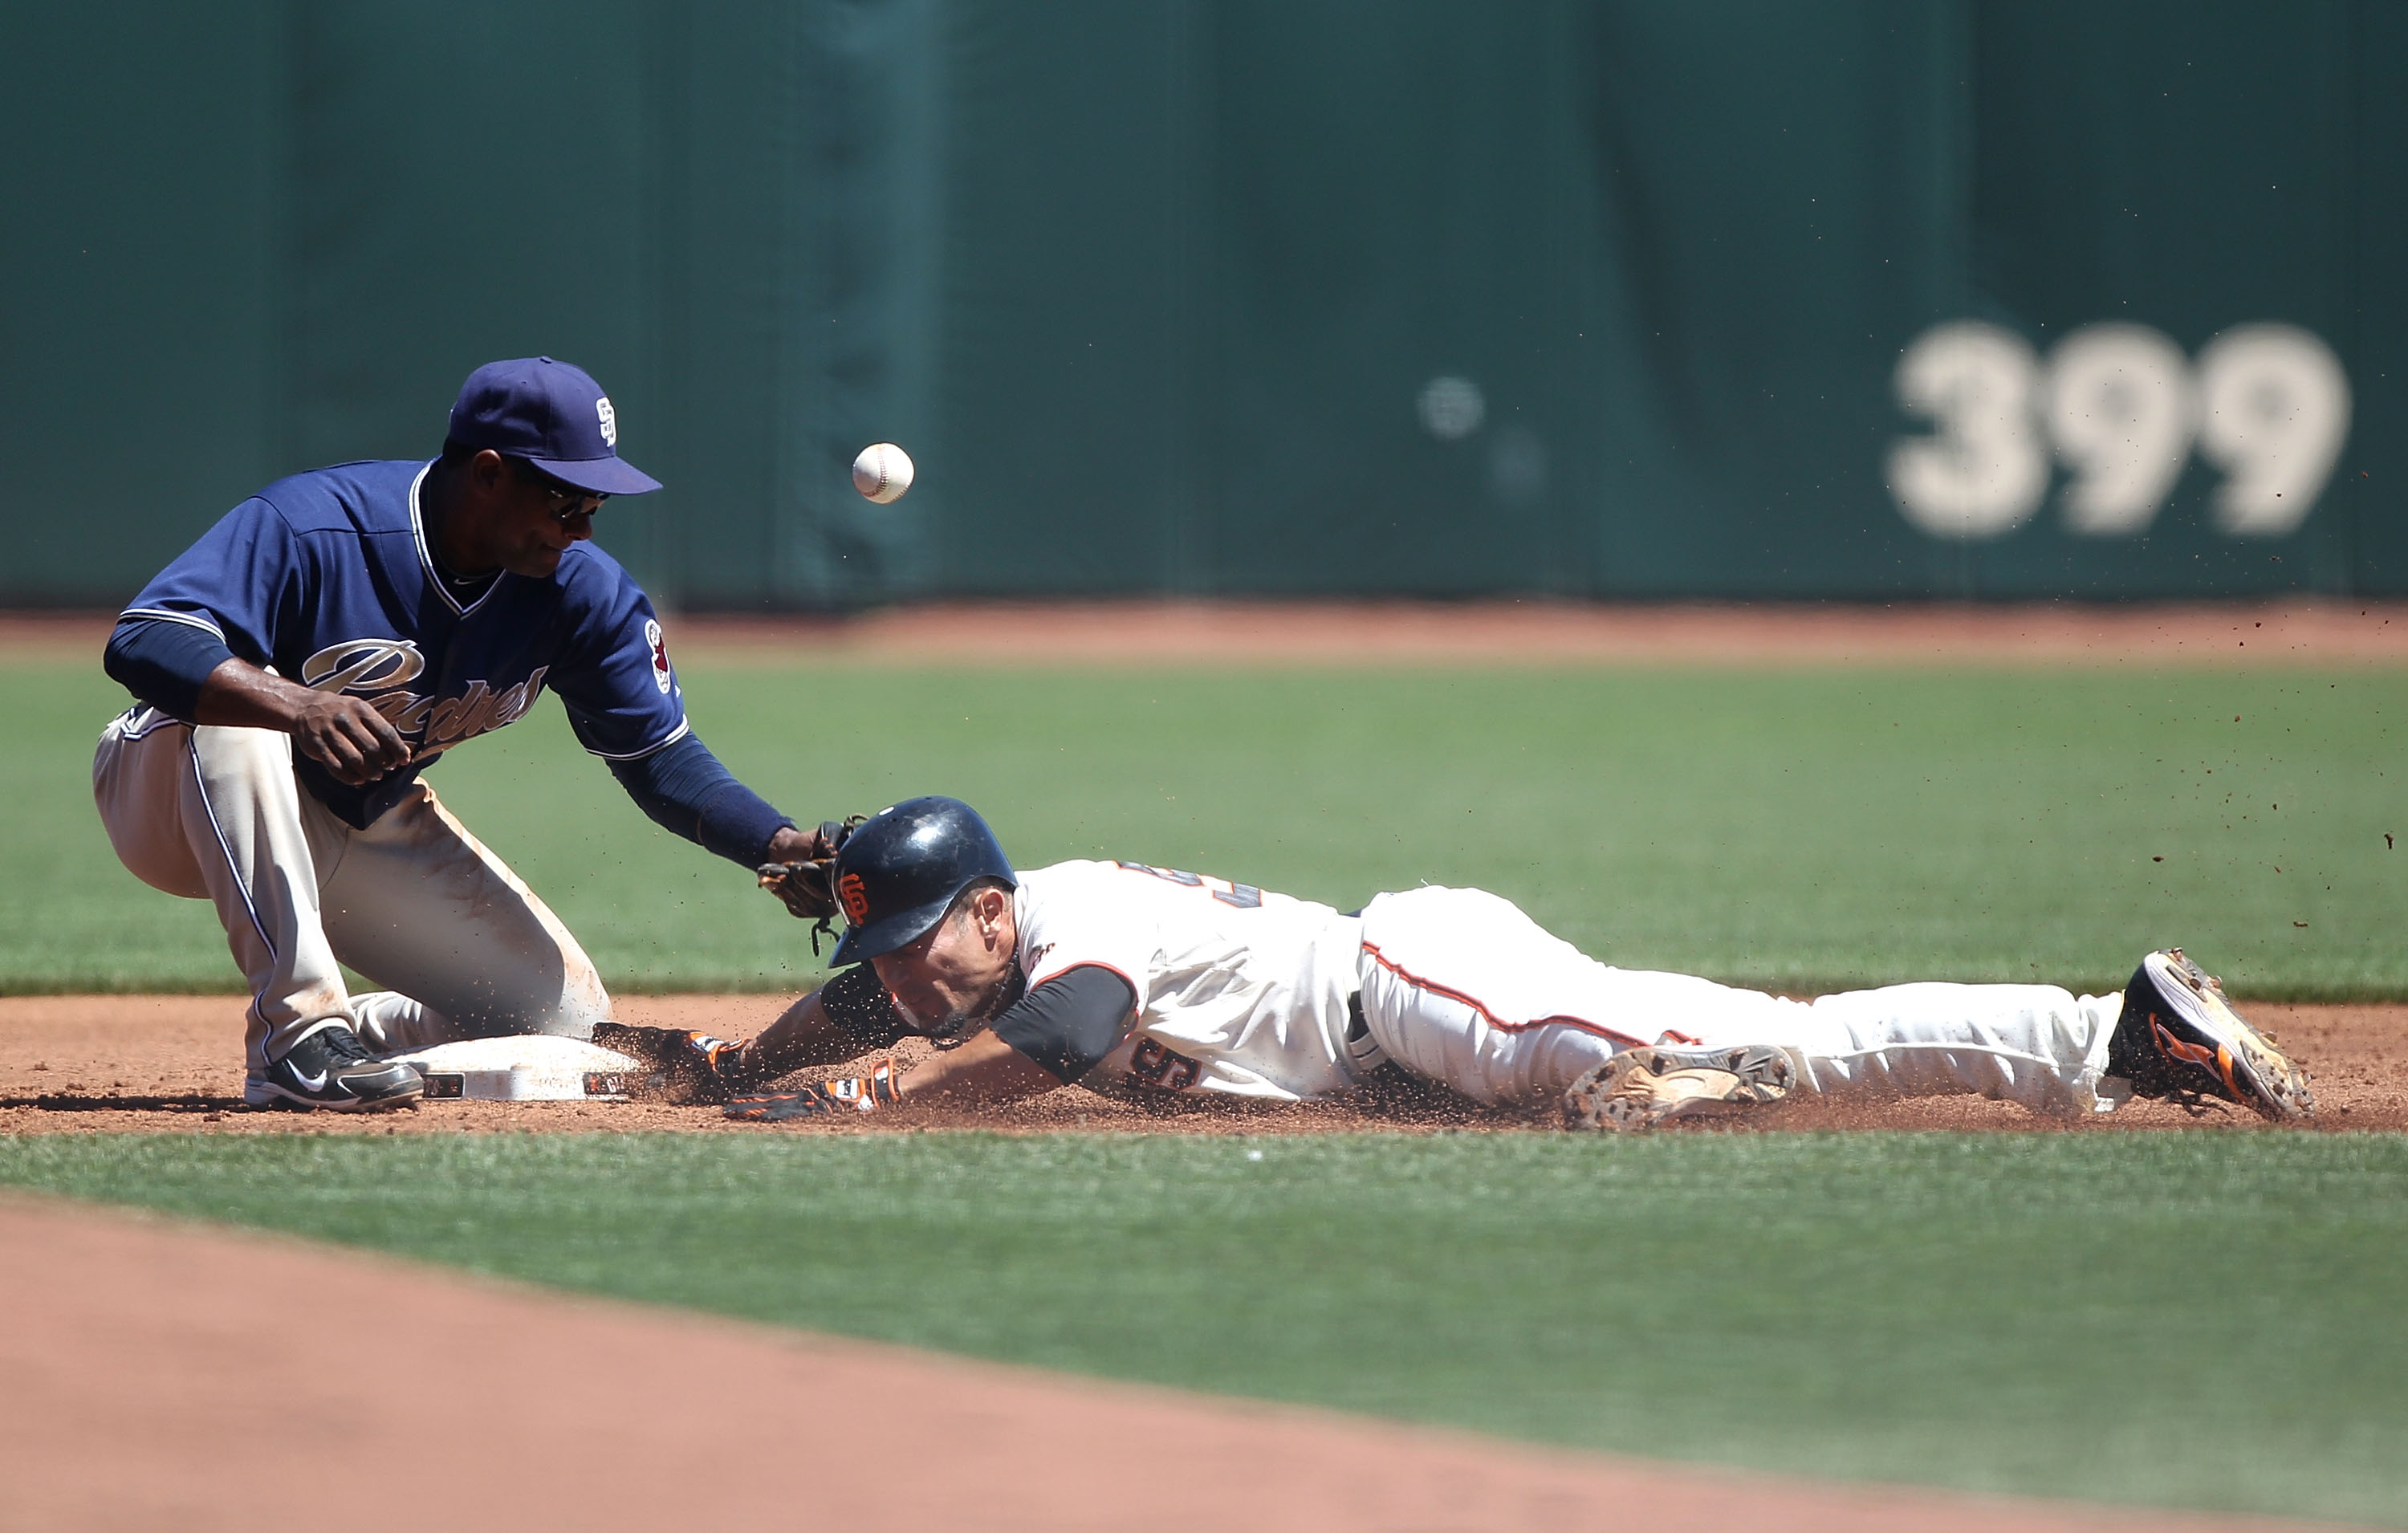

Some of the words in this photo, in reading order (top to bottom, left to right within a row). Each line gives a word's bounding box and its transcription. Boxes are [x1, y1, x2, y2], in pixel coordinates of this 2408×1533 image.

[596, 396, 616, 447] SD
[1885, 323, 2353, 537] 399
[302, 638, 550, 746] Padres
[840, 873, 869, 925] SF
